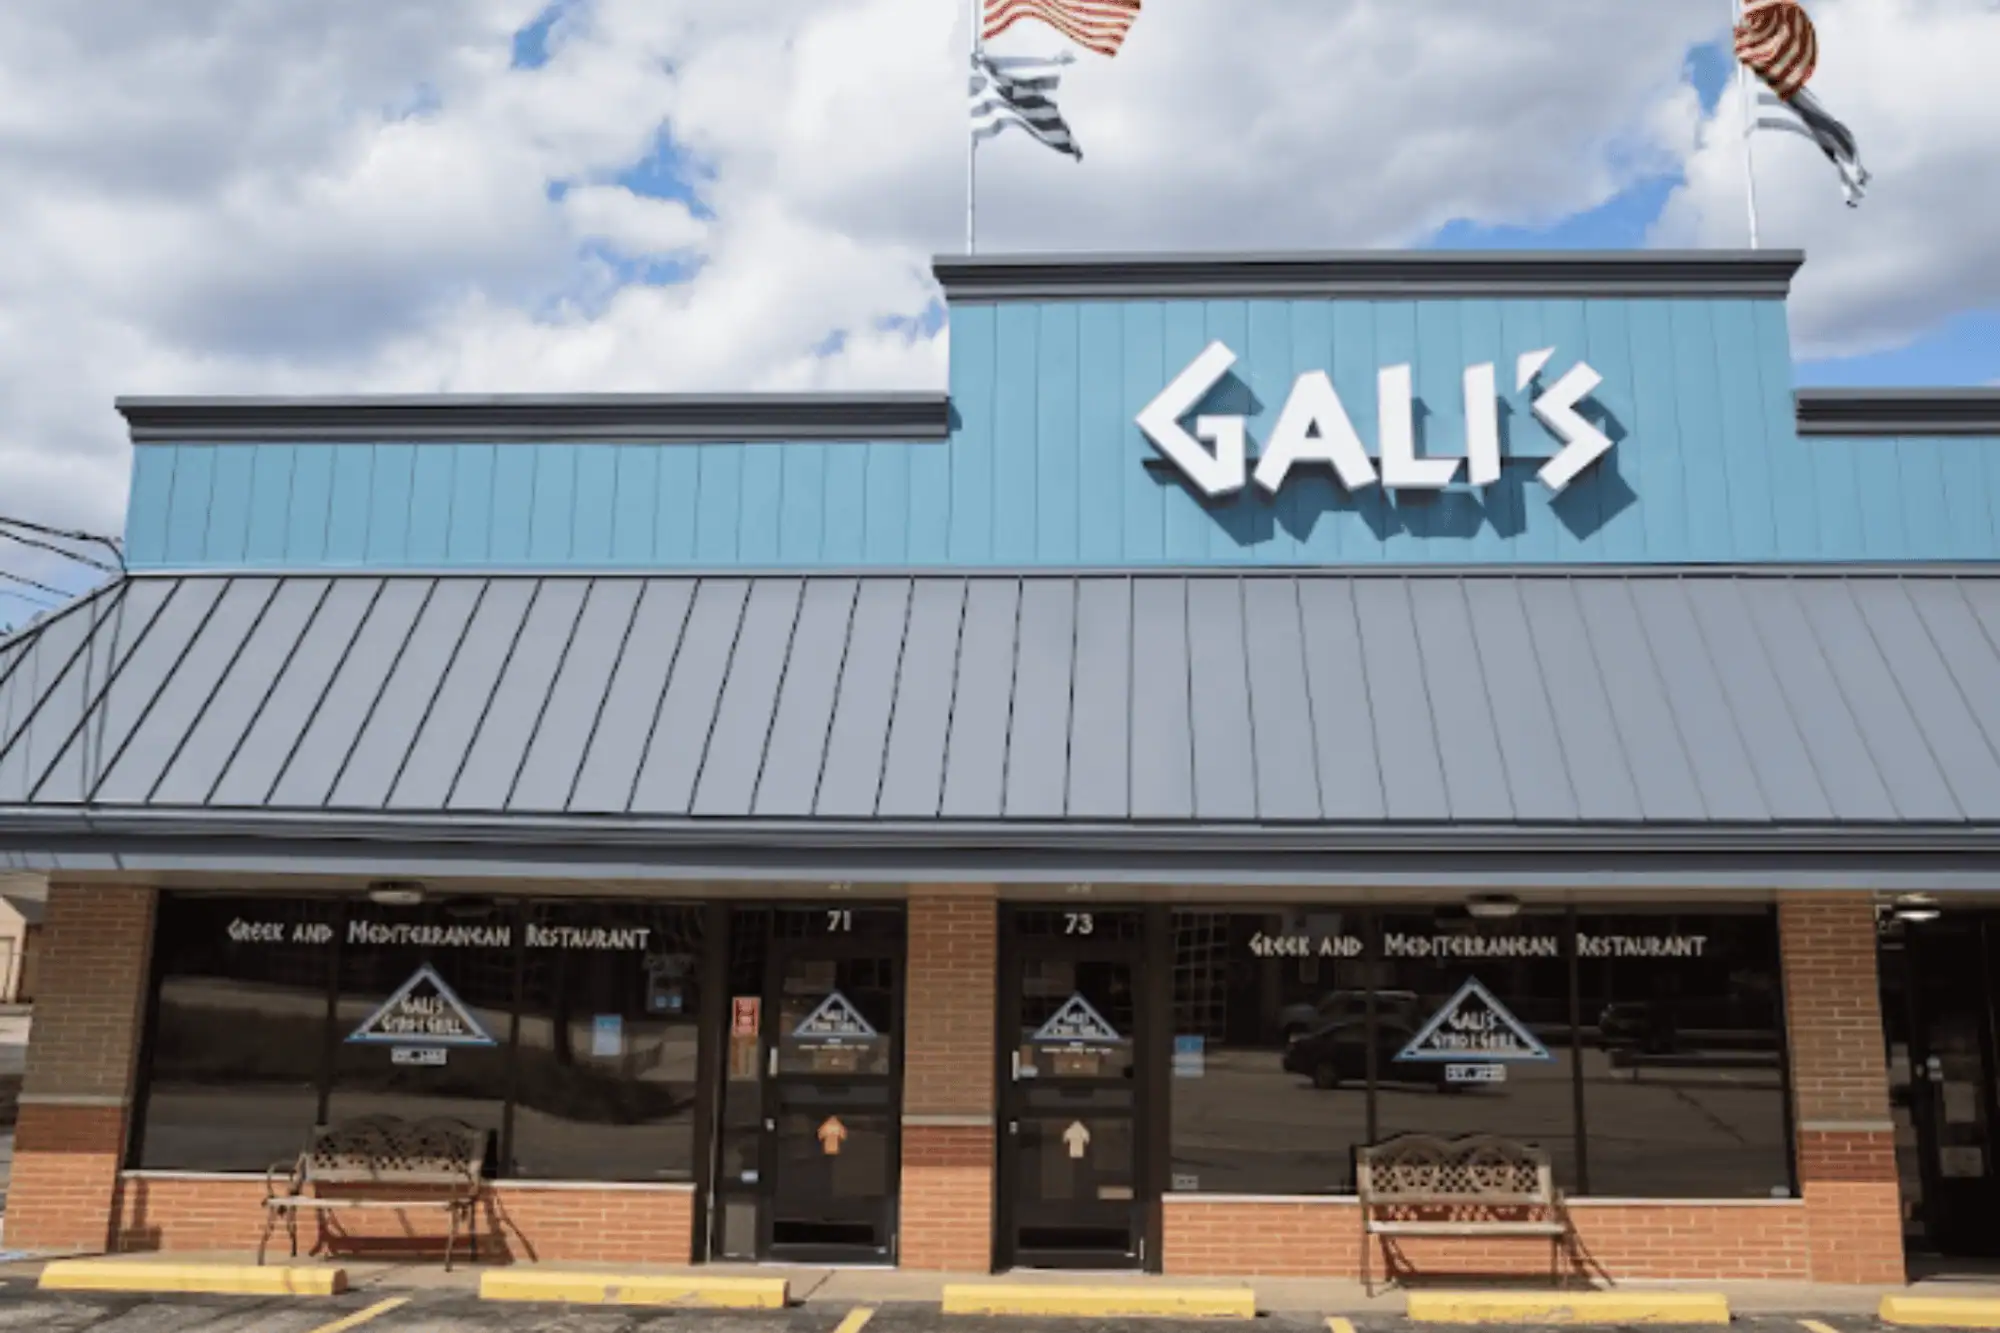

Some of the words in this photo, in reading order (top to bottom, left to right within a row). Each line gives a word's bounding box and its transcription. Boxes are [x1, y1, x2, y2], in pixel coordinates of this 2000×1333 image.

[1134, 339, 1613, 497] GALI'S
[227, 916, 285, 943] GREEK
[292, 922, 335, 944] AND
[346, 919, 511, 948] MEDITERRANEAN
[524, 922, 651, 950] RESTAURANT
[827, 909, 852, 932] 71
[1064, 912, 1094, 935] 73
[1248, 930, 1310, 957] GREEK
[1318, 935, 1364, 957] AND
[1383, 932, 1559, 957] MEDITERRANEAN
[1575, 932, 1708, 957] RESTAURANT
